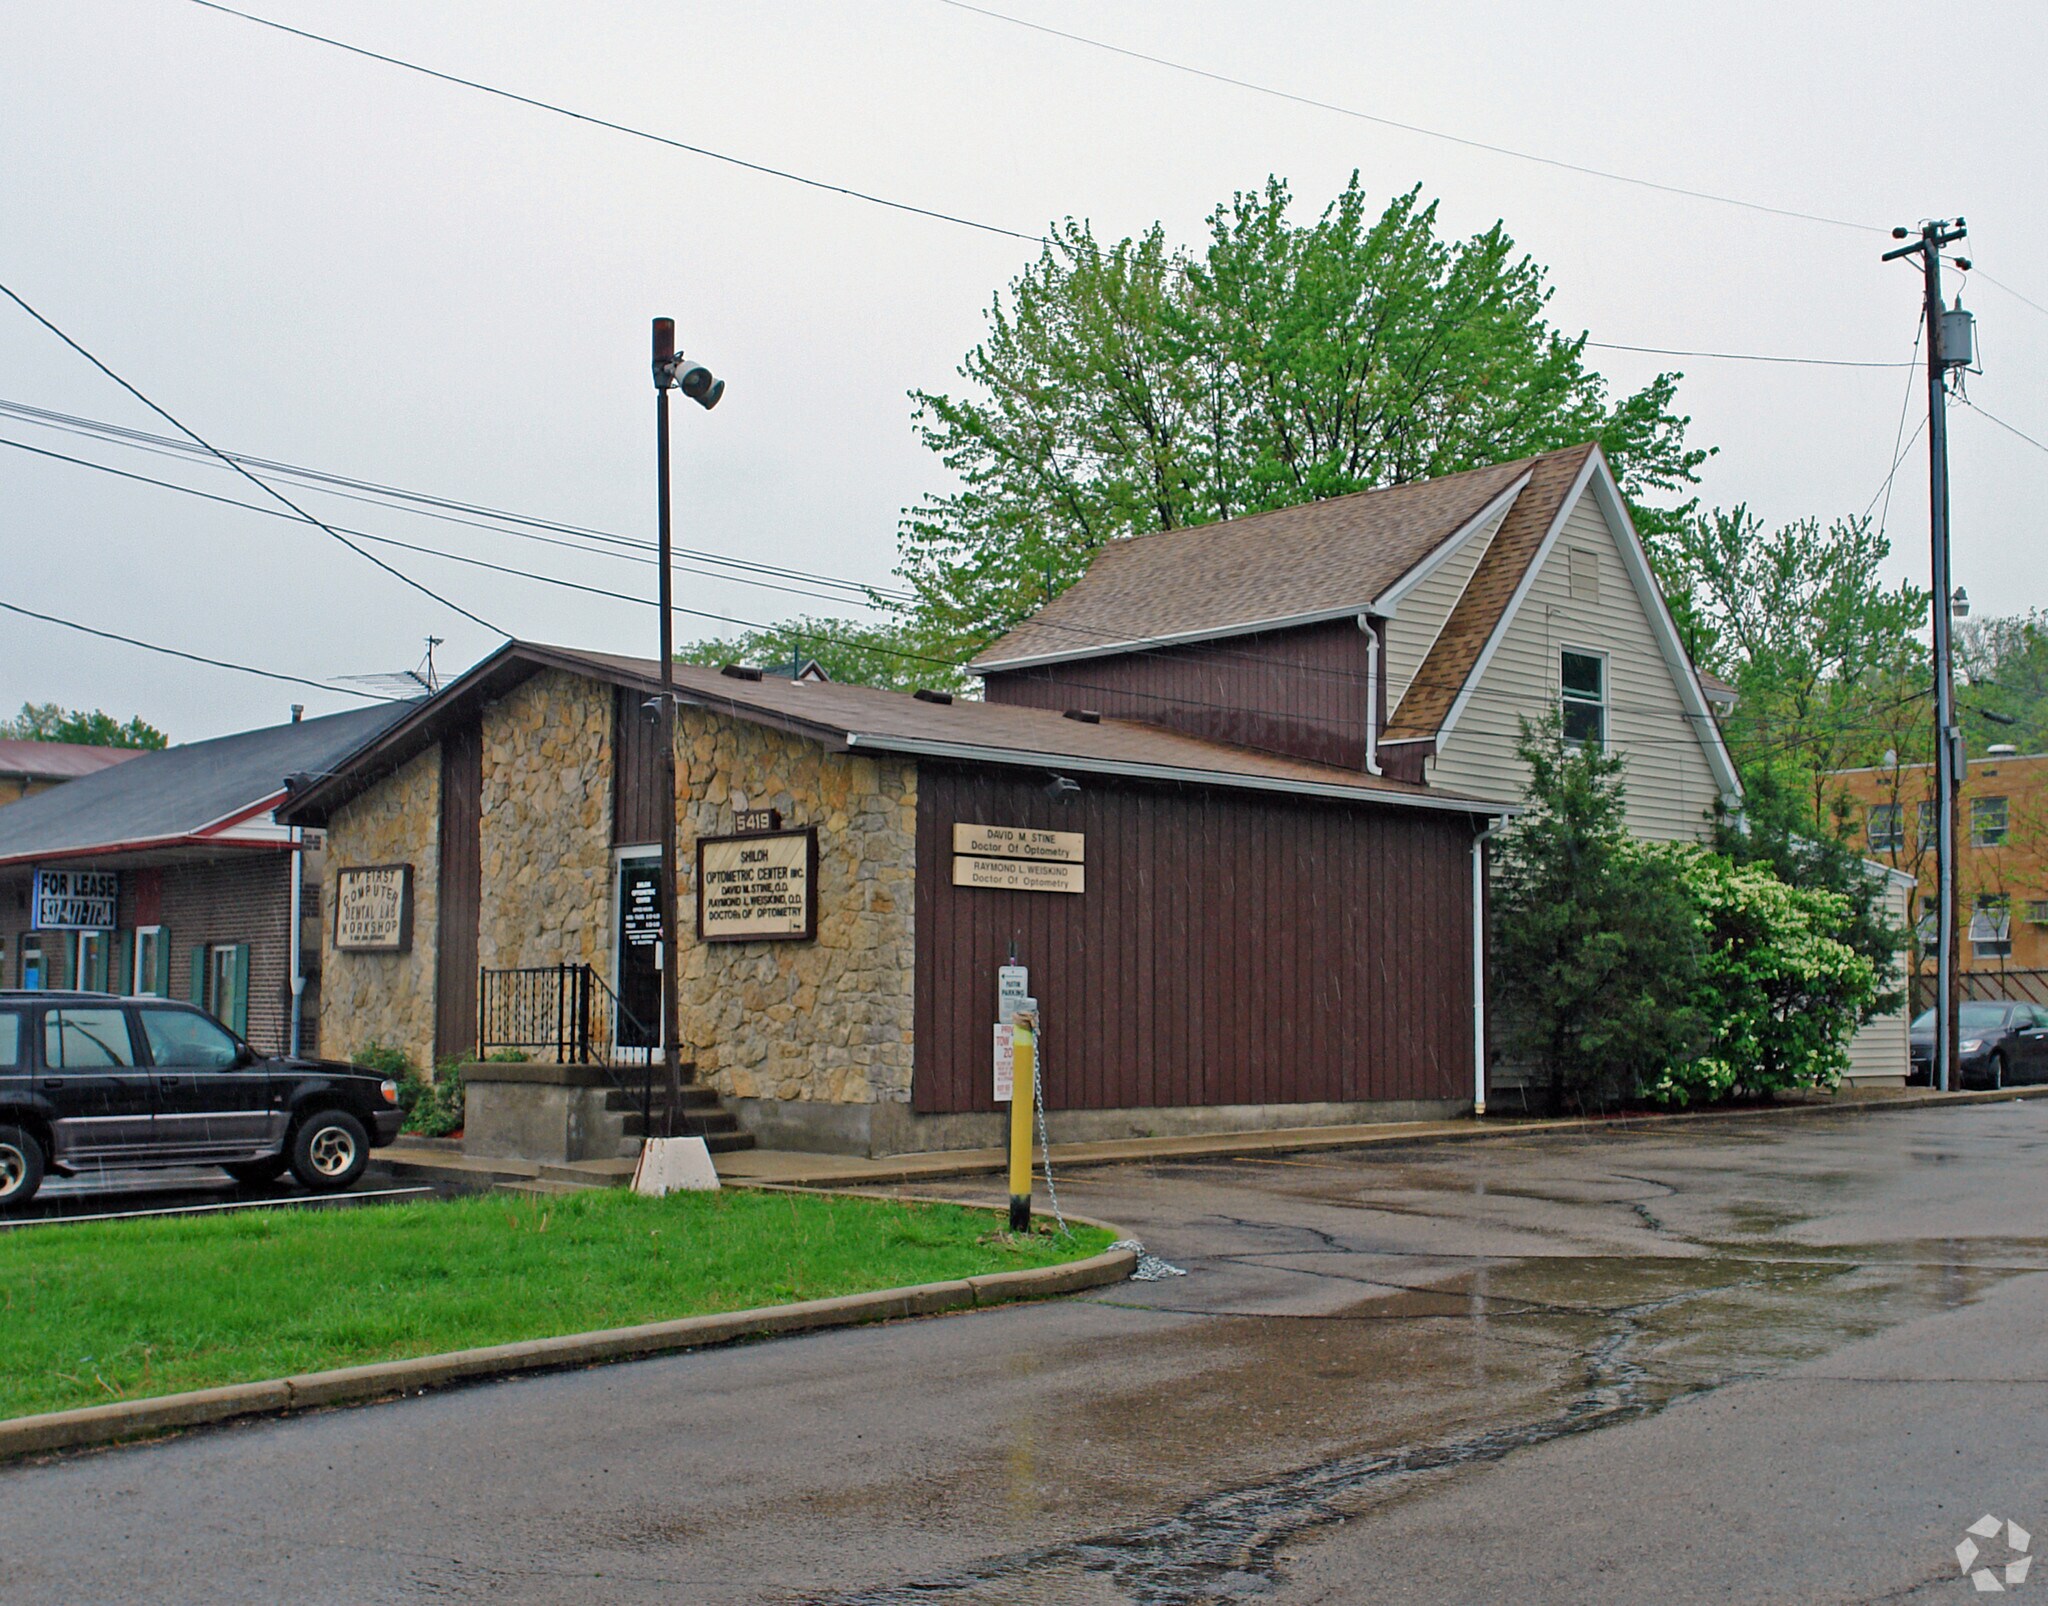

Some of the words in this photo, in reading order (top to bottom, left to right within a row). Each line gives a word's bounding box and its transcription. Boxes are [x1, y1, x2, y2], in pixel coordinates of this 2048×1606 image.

[987, 829, 1013, 840] DAVID
[1031, 833, 1056, 844] STINE
[740, 849, 769, 863] SHILOH
[971, 840, 1001, 851] Doctor
[1008, 843, 1019, 852] Of
[1024, 844, 1070, 858] Optometry
[706, 868, 754, 884] OPTOMETRIC
[757, 867, 788, 880] CENTER
[974, 861, 1016, 873] RAYMOND
[1027, 866, 1068, 876] WEISKIND
[349, 871, 361, 884] MY
[366, 870, 395, 883] FIRST
[972, 873, 1002, 884] Doctor
[1007, 876, 1018, 884] Of
[1023, 877, 1069, 889] Optometry
[41, 873, 68, 896] FOR
[74, 874, 115, 897] LEASE
[721, 884, 742, 895] DAVID
[343, 885, 398, 907] COMPUTER
[708, 897, 742, 908] RAYMOND
[345, 906, 374, 920] DENTAL
[380, 903, 396, 919] LAB
[742, 909, 753, 919] OF
[757, 907, 802, 918] OPTOMETRY
[342, 921, 398, 935] WORKSHOP
